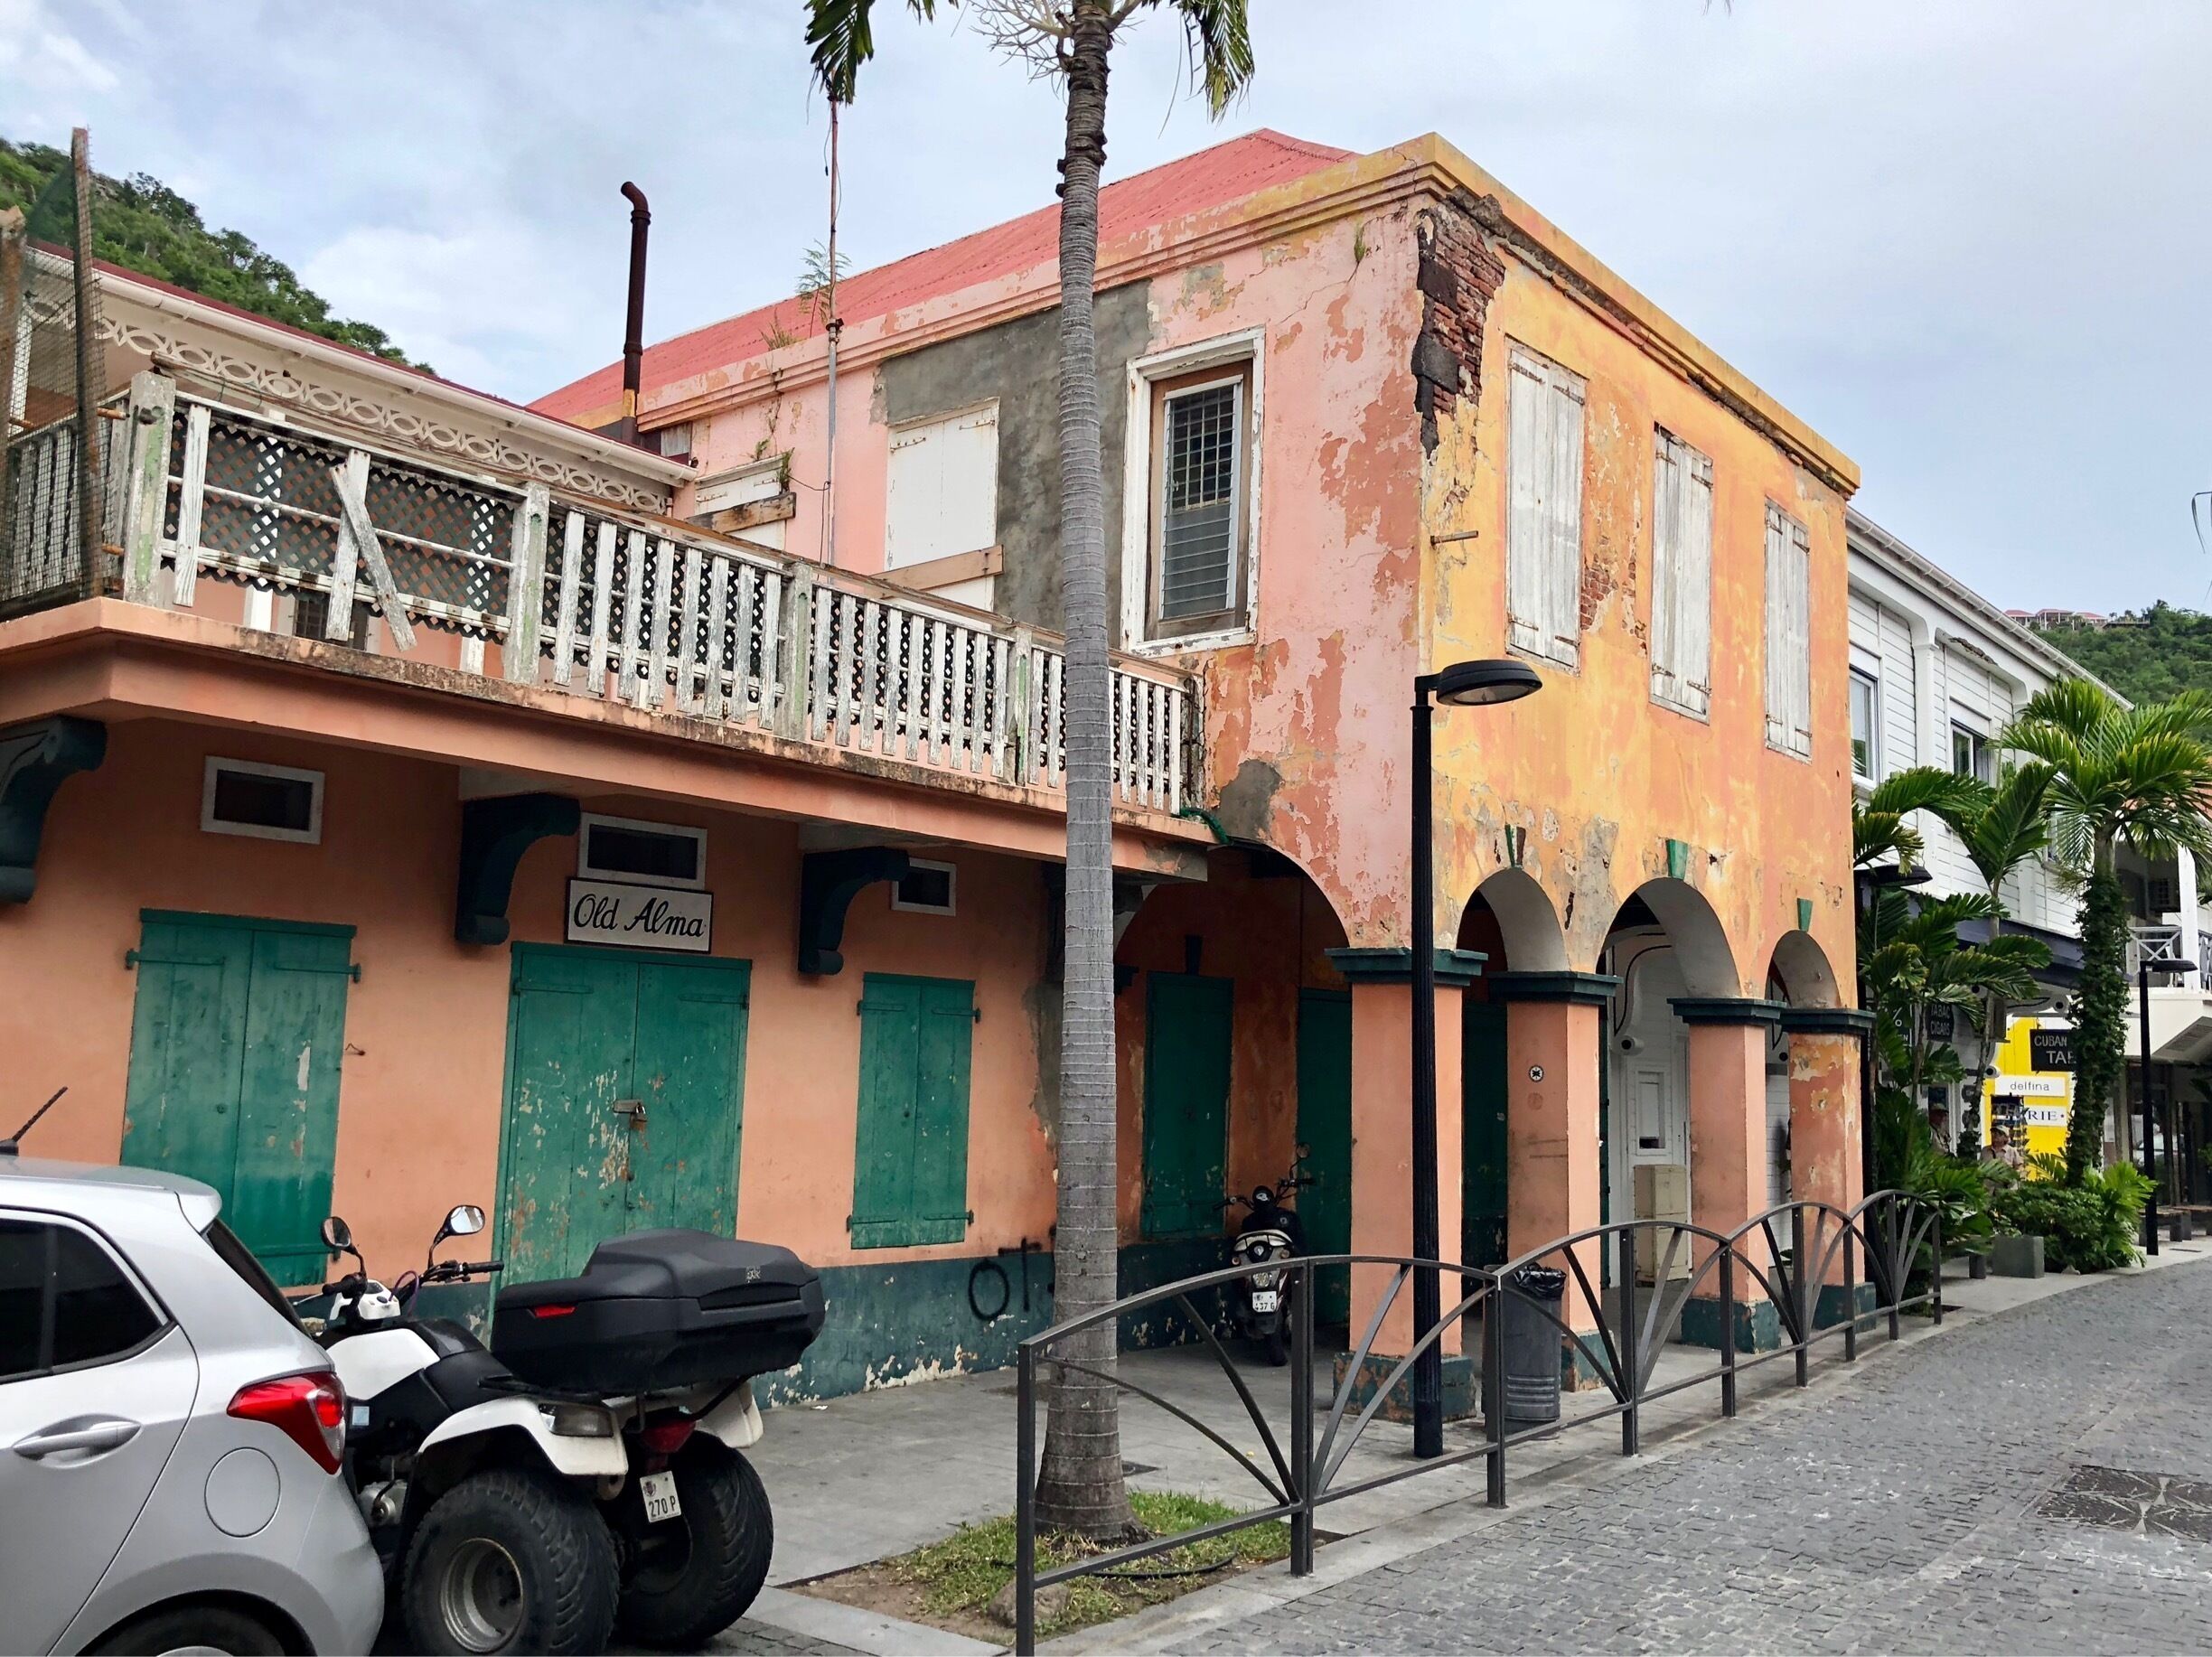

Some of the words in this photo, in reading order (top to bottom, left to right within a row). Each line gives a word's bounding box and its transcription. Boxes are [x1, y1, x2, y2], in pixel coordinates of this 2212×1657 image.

[574, 893, 620, 931] Old
[623, 897, 705, 938] Alma
[2034, 1034, 2067, 1047] CUBAN
[2010, 1081, 2050, 1091] delfina
[2028, 1110, 2057, 1121] RIE
[648, 1497, 668, 1517] 270
[670, 1495, 676, 1512] P
